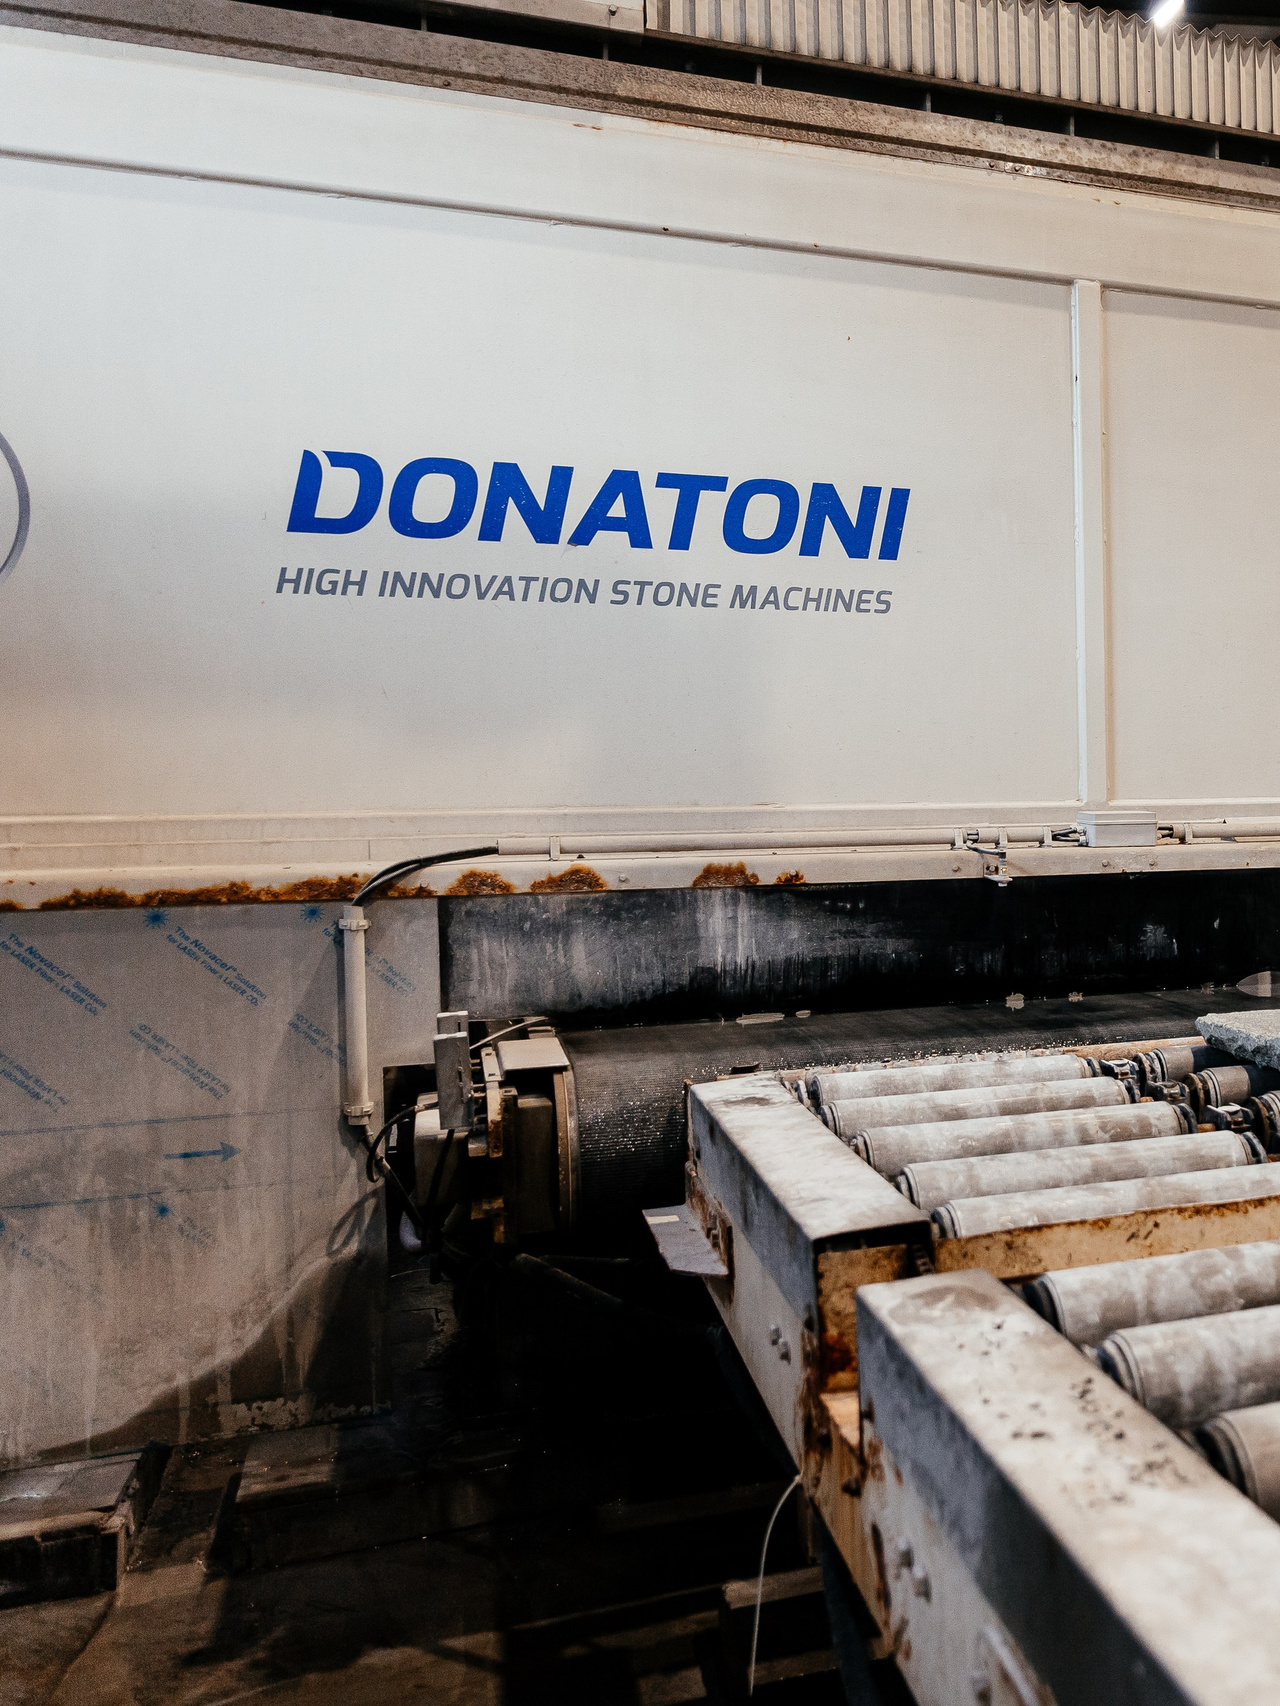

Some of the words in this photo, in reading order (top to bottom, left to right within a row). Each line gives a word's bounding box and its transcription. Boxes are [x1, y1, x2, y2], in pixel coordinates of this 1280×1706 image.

[286, 449, 911, 561] DONATONI
[275, 566, 369, 597] HIGH
[378, 570, 601, 605] INNOVATION
[610, 578, 722, 609] STONE
[729, 584, 893, 614] MACHINES
[9, 933, 24, 948] The
[72, 980, 108, 1008] Solution
[10, 950, 36, 970] LASER
[60, 985, 85, 1005] LASER
[166, 934, 177, 944] for
[177, 943, 201, 961] LASER
[223, 977, 247, 997] LASER
[175, 926, 190, 941] The
[235, 973, 267, 1000] Solution
